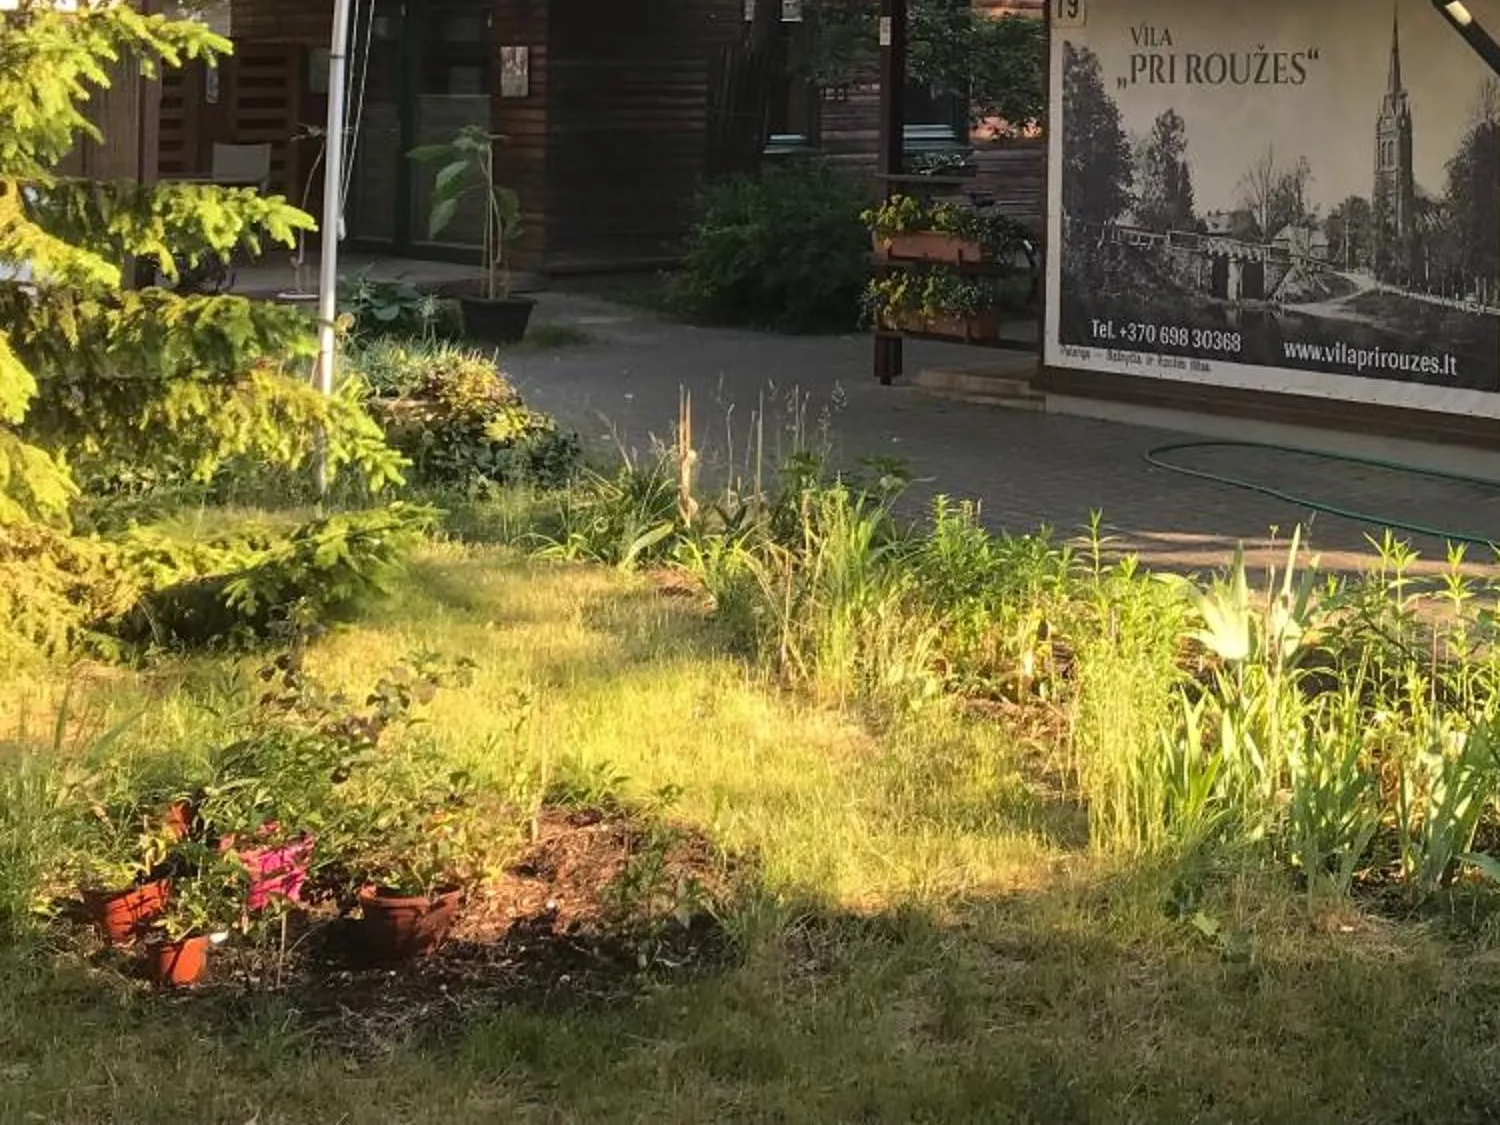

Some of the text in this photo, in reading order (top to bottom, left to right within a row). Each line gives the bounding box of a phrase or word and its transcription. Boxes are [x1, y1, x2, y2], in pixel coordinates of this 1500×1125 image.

[1130, 26, 1173, 47] VILA
[1092, 319, 1241, 352] Tel. +370 698 30368
[1283, 341, 1458, 375] www.vilaprirouzes.lt
